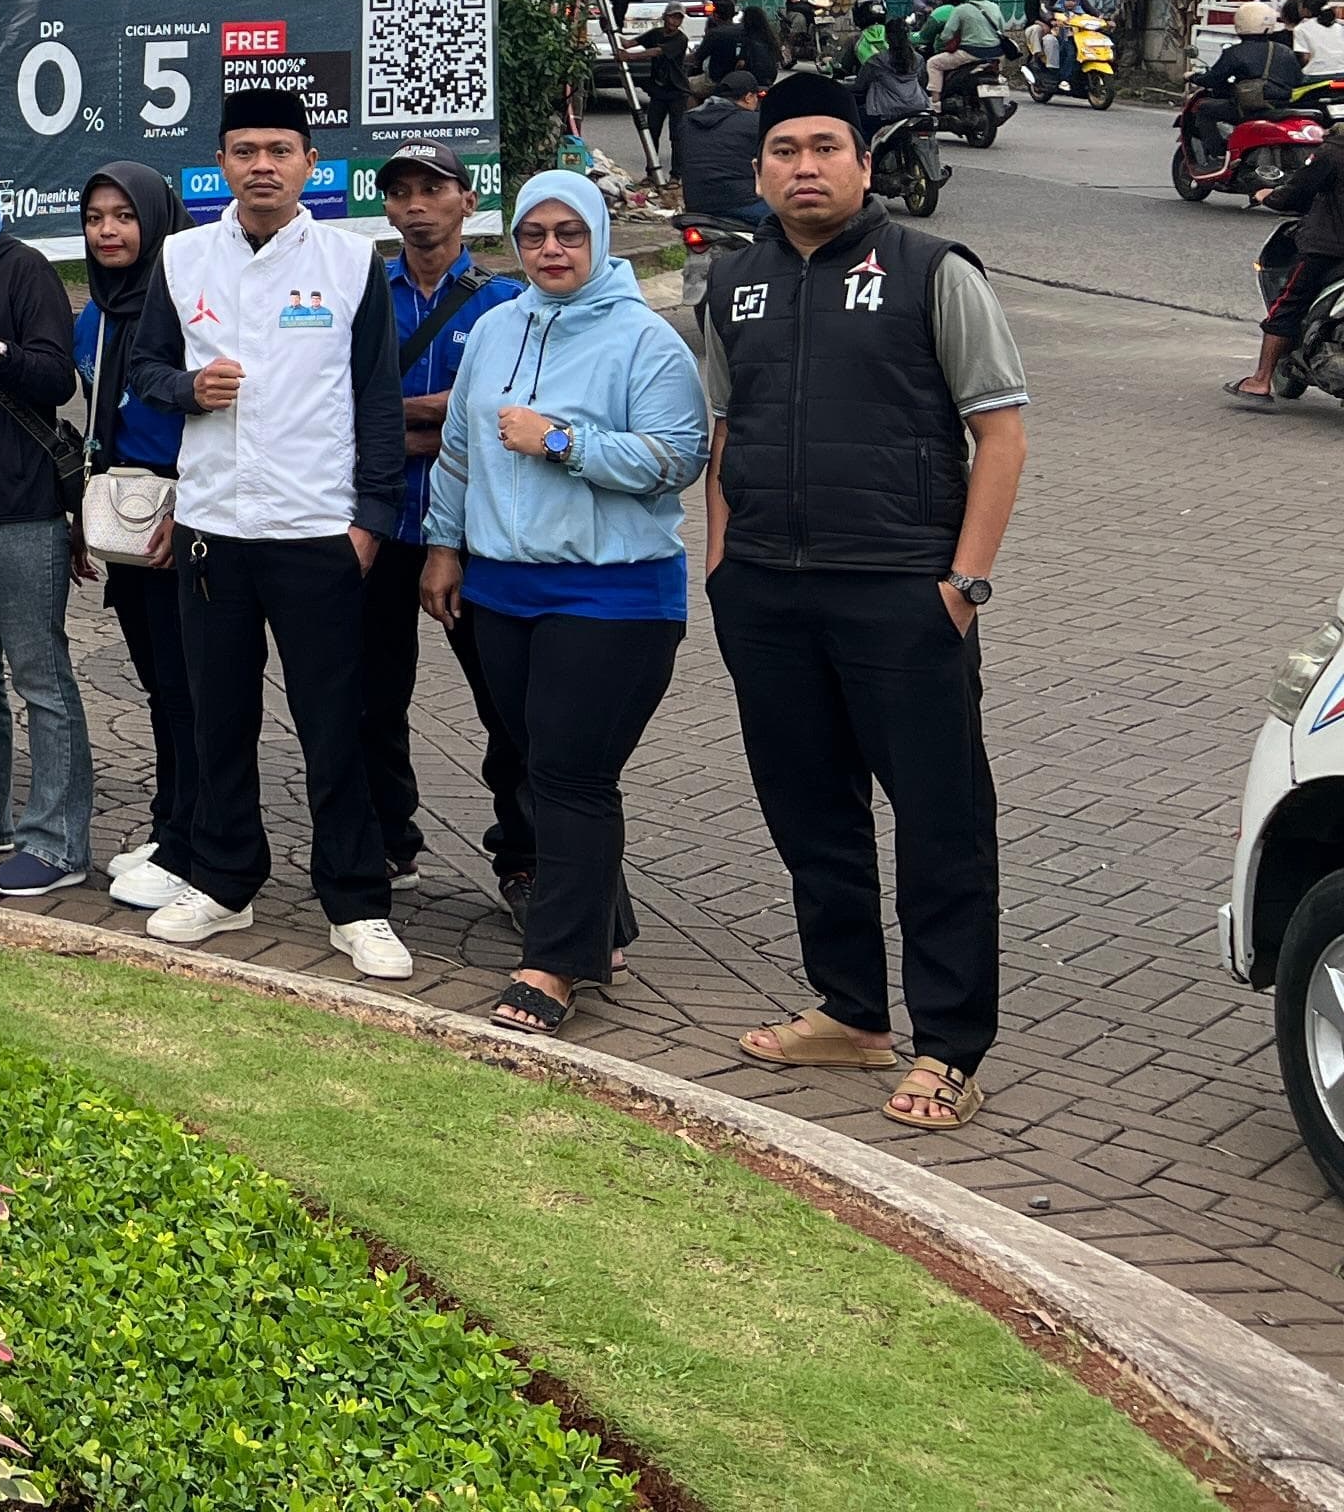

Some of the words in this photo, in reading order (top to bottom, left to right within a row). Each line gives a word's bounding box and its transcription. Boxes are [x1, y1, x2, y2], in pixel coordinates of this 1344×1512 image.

[40, 21, 64, 38] DP
[125, 24, 171, 37] CICILAN
[174, 23, 211, 35] MULAI
[225, 30, 279, 51] FREE
[224, 60, 257, 76] PPN
[139, 41, 191, 127] 5
[224, 77, 271, 94] BIAYA
[305, 109, 348, 125] MAR
[372, 130, 399, 141] SCAN
[401, 129, 422, 139] FOR
[423, 128, 453, 138] MORE
[455, 127, 480, 137] INFO
[191, 173, 219, 193] 021
[465, 163, 502, 195] 799
[16, 188, 38, 218] 10
[38, 188, 67, 204] menit
[67, 188, 80, 202] ke
[739, 293, 761, 311] JF
[844, 275, 884, 312] 14
